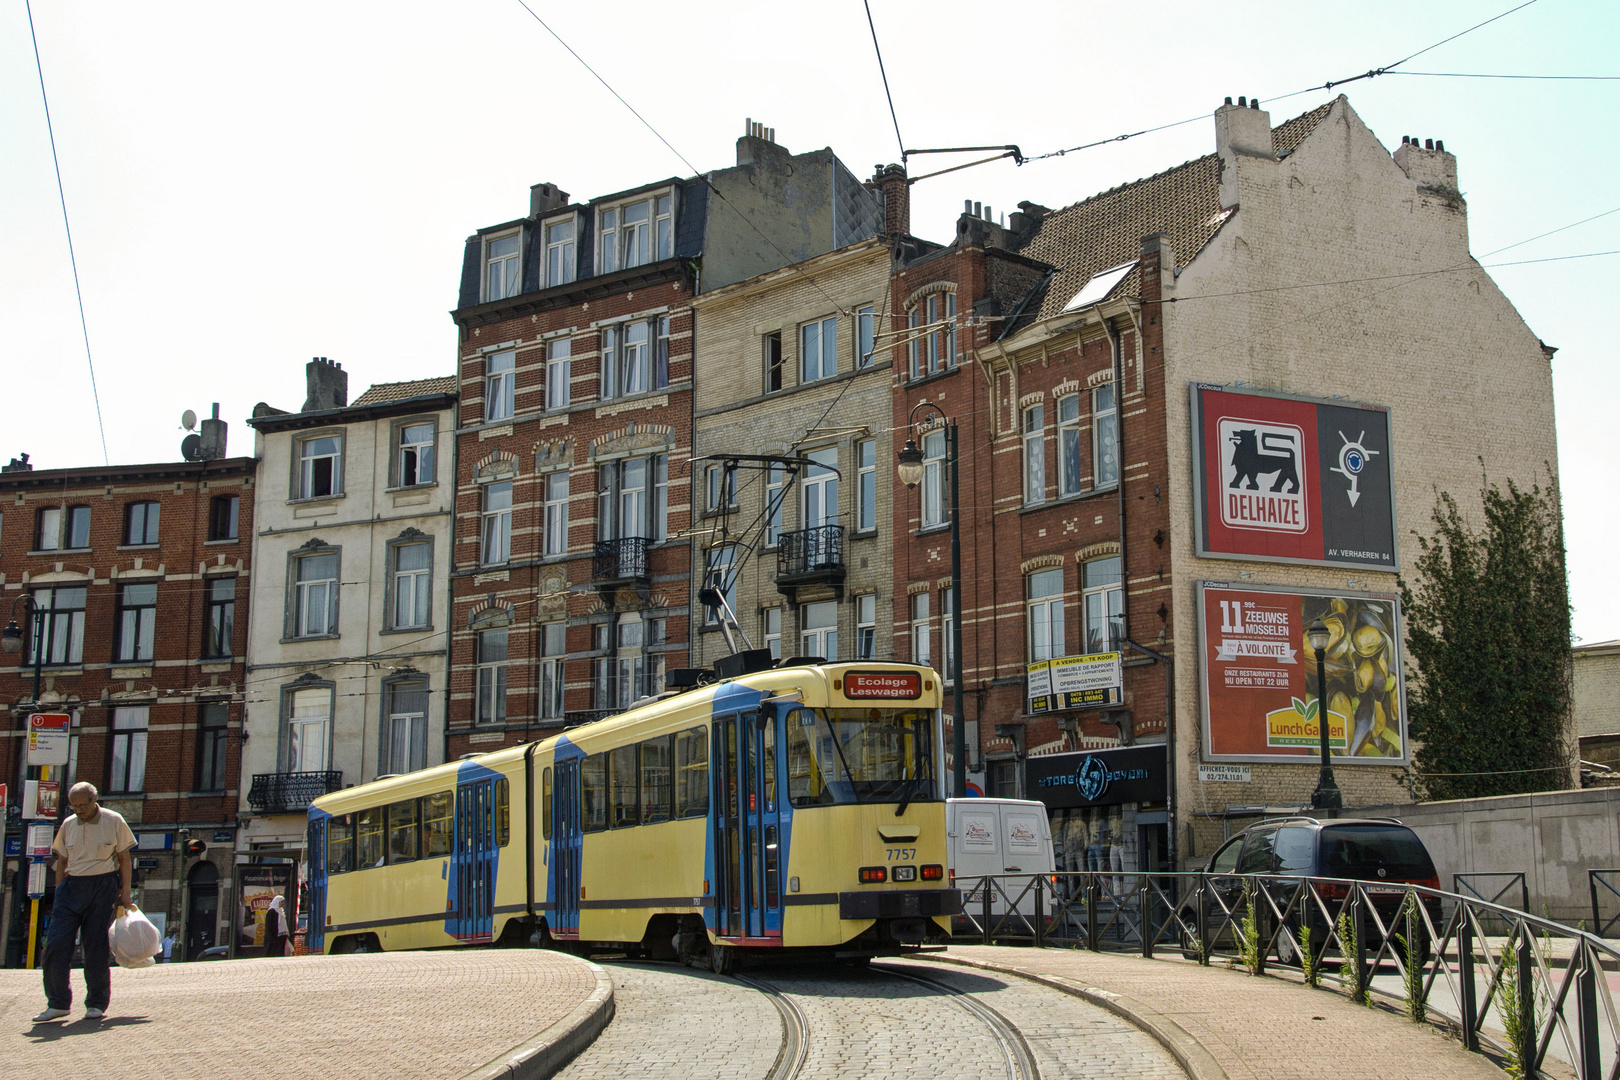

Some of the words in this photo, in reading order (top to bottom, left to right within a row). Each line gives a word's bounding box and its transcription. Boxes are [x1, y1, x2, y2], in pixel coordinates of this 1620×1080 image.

[1229, 493, 1299, 525] DELHAIZE
[1341, 549, 1379, 559] VERHAEREN
[1245, 611, 1289, 624] ZEEUWSE
[1246, 624, 1289, 636] MOSSELEN
[1246, 643, 1285, 656] VOLONTÉ
[1239, 670, 1275, 678] RESTAURANTS
[858, 677, 907, 687] Ecolage
[1060, 676, 1112, 687] OPBRENGSTWONING
[850, 688, 914, 697] Leswagen
[1084, 694, 1104, 702] IMMO
[1270, 722, 1303, 736] Lunch
[886, 848, 917, 860] 7757
[253, 899, 271, 908] LUTOS
